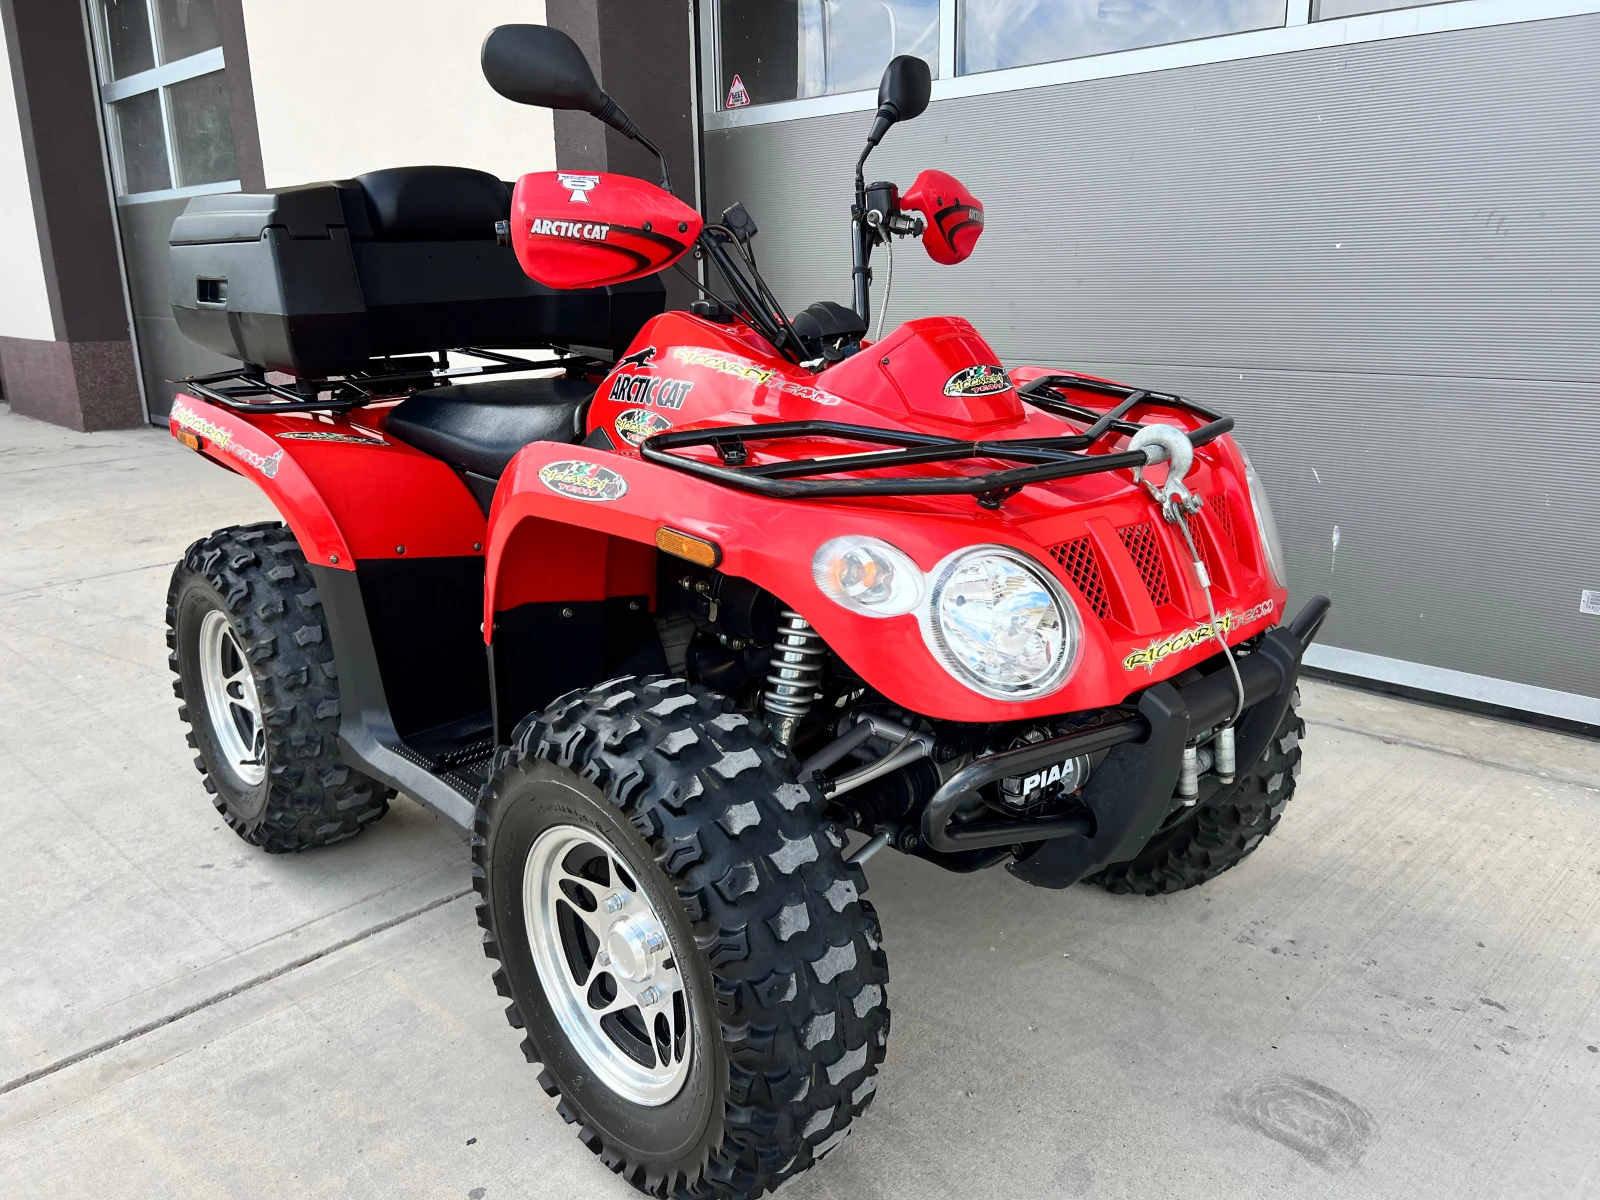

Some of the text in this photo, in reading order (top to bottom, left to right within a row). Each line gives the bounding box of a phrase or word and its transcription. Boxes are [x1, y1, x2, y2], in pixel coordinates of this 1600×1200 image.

[529, 218, 610, 241] ARCTIC CAT
[607, 373, 695, 411] ARCTIC CAT
[673, 347, 842, 406] RICCARDI TEAM
[174, 407, 231, 449] RICCARDI
[539, 468, 607, 491] RICCARDI
[558, 482, 598, 497] TEAM
[1123, 598, 1274, 672] RICCARDI TEAM
[1022, 757, 1075, 796] PIAA
